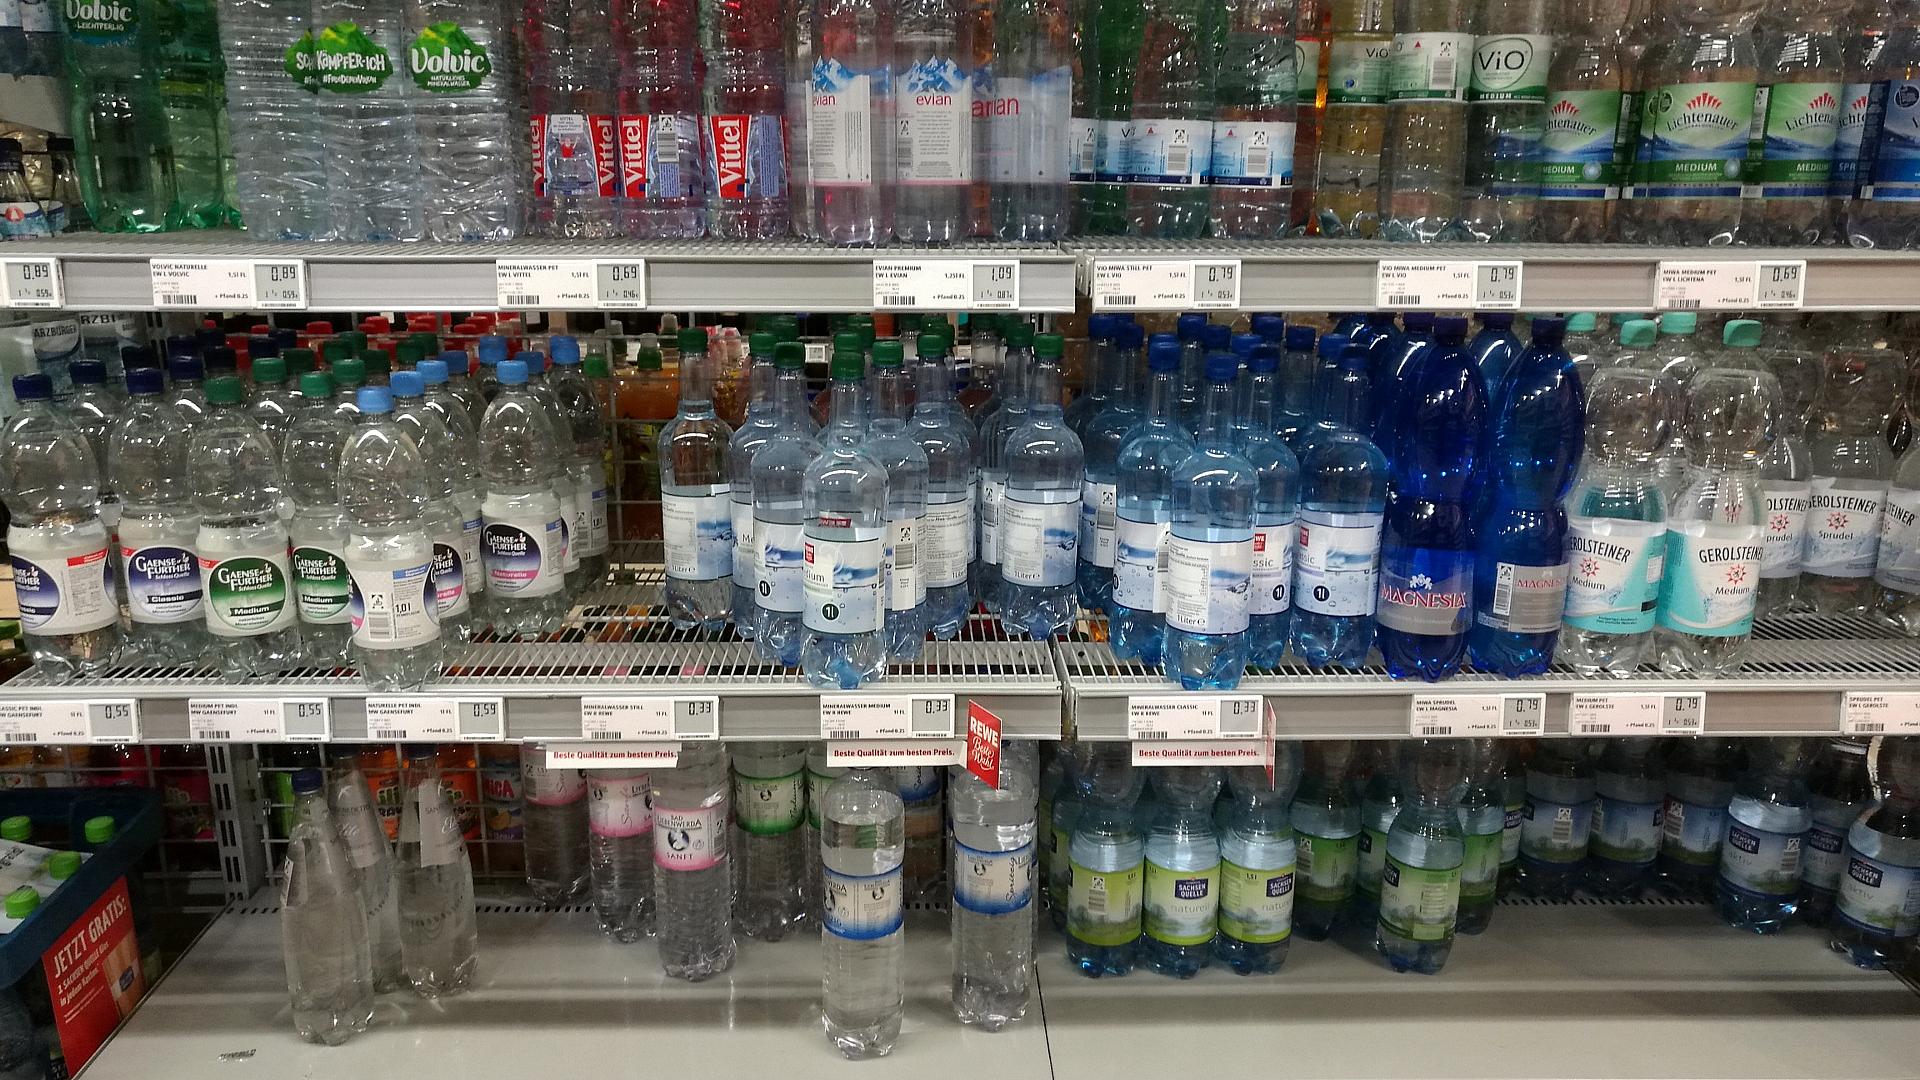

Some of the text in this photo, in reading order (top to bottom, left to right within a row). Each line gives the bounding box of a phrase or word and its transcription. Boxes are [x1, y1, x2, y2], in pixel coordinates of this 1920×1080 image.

[411, 47, 485, 73] Volvic
[1479, 51, 1525, 71] ViO
[916, 92, 952, 106] evian
[1667, 112, 1738, 133] Lichtenauer
[599, 118, 613, 186] Vittel
[622, 118, 642, 186] Vittel
[720, 118, 742, 187] Vittel
[1675, 163, 1717, 173] MEDIUM
[612, 266, 637, 281] 0.69
[1208, 266, 1233, 282] 0.79
[1490, 267, 1514, 282] 0.79
[1767, 499, 1807, 512] OLSTEINER
[1766, 533, 1793, 543] prudel
[1818, 530, 1854, 541] Sprudel
[492, 542, 527, 553] FURTHER
[1570, 536, 1631, 563] EROLSTEINER
[1253, 559, 1274, 568] ssic
[230, 573, 273, 592] FURTHER
[1572, 576, 1606, 591] Medium
[1381, 584, 1466, 609] MAGNESIA
[1715, 586, 1750, 596] Medium
[151, 594, 185, 603] Classic
[304, 595, 333, 603] Medium
[234, 606, 270, 615] Medium
[298, 704, 322, 718] 0.55
[473, 703, 496, 717] 0.59
[688, 702, 711, 716] 0.33
[925, 700, 948, 714] 0.33
[1233, 701, 1256, 715] 0.33
[1675, 697, 1698, 711] 0.79
[105, 705, 129, 719] 0.55
[969, 716, 999, 748] REWE
[553, 751, 575, 759] Beste
[577, 751, 608, 760] Qualität
[655, 750, 677, 758] Preis.
[834, 750, 855, 758] Beste
[857, 749, 888, 758] Qualität
[906, 749, 932, 757] besten
[933, 748, 955, 757] Preis.
[972, 737, 995, 759] Beste
[1161, 749, 1193, 757] Qualität
[1211, 749, 1236, 757] besten
[1238, 748, 1260, 756] Preis.
[667, 851, 693, 860] SANFT
[1851, 863, 1879, 879] SACHSEN
[1178, 883, 1206, 891] SACHSEN
[1270, 878, 1292, 889] SACHSEN
[1180, 890, 1203, 898] QUELLE
[54, 895, 127, 979] JETZT GRATIS:
